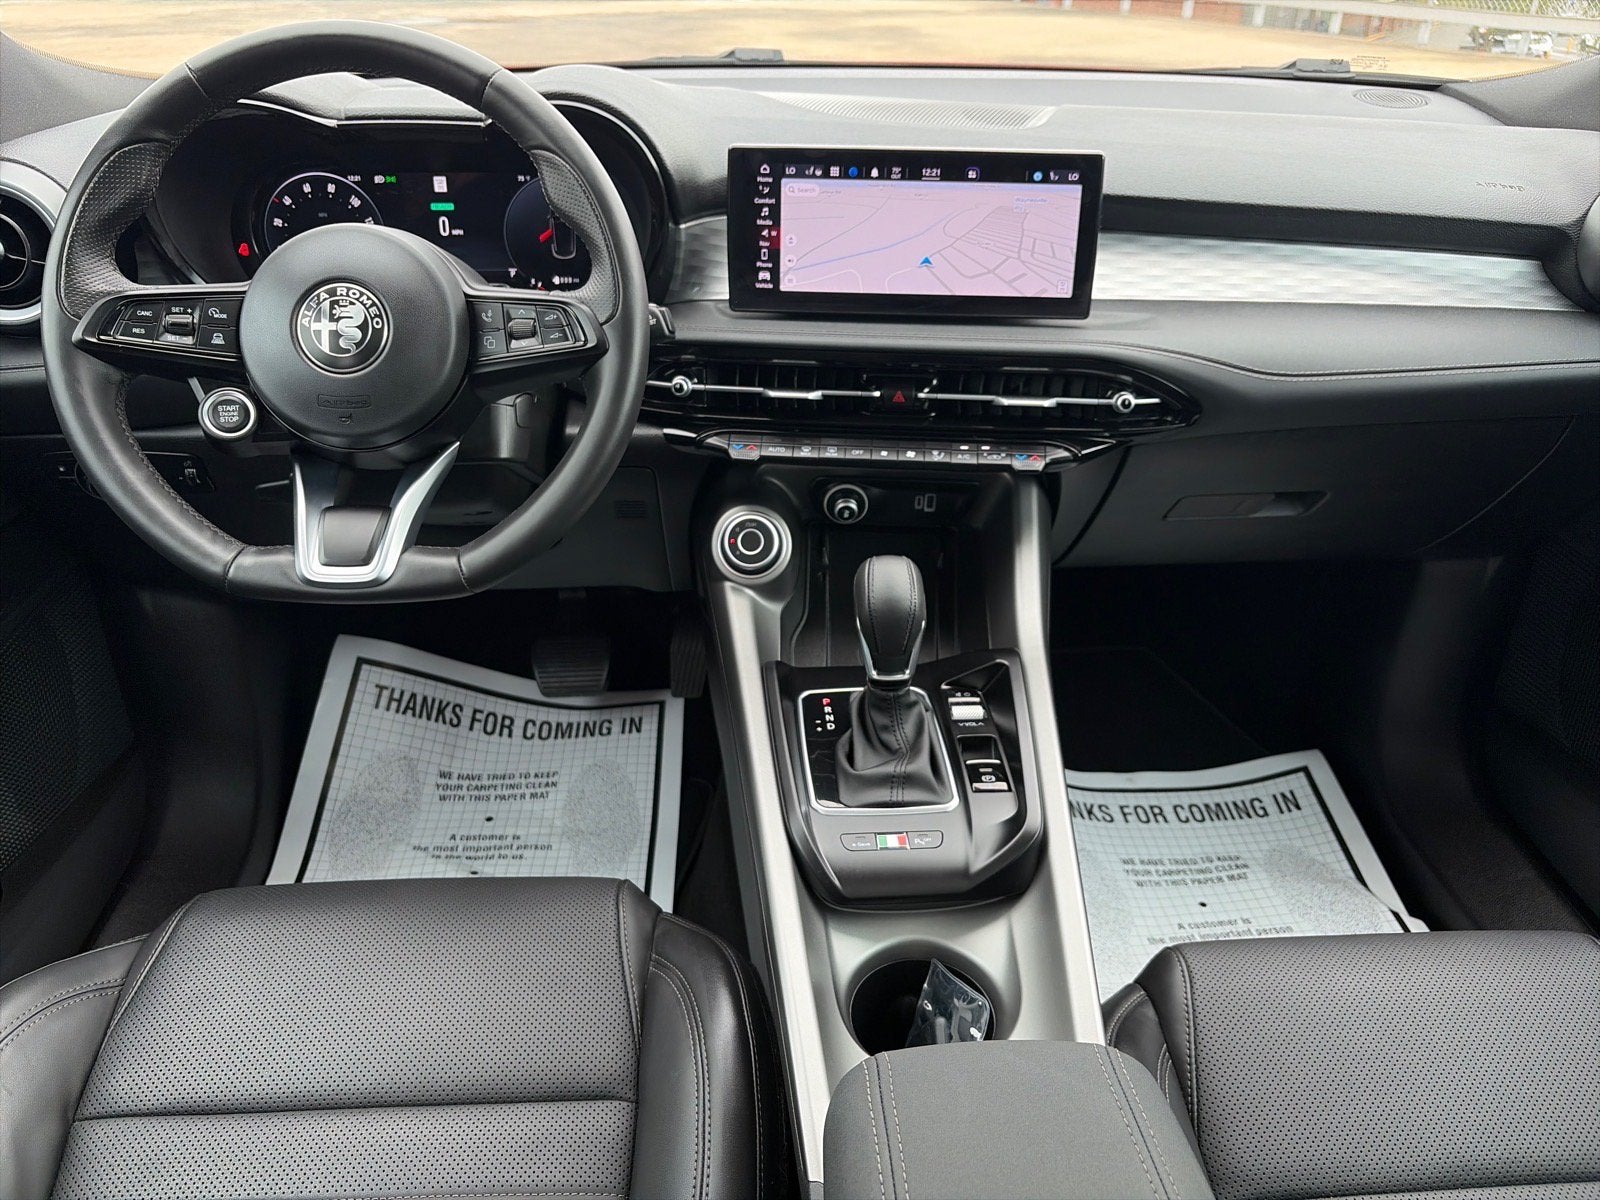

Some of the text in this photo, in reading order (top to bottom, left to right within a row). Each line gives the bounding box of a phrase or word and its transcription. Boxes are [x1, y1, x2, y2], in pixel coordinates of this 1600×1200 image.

[922, 168, 941, 177] 12:21
[301, 287, 383, 329] ALFA ROMEO
[822, 697, 831, 705] P
[374, 684, 643, 741] THANKS FOR COMING IN
[826, 722, 836, 730] D
[439, 770, 559, 781] WE HAVE TRIED TO KEEP
[434, 780, 559, 792] YOUR CARPETING CLEAN
[439, 790, 550, 802] WITH THIS PAPER MAT
[1118, 804, 1169, 824] FOR
[1172, 797, 1269, 824] COMING
[1272, 789, 1302, 815] IN
[449, 833, 457, 841] A
[460, 833, 510, 841] customer
[432, 844, 460, 853] most
[462, 843, 514, 854] important
[516, 842, 553, 852] person
